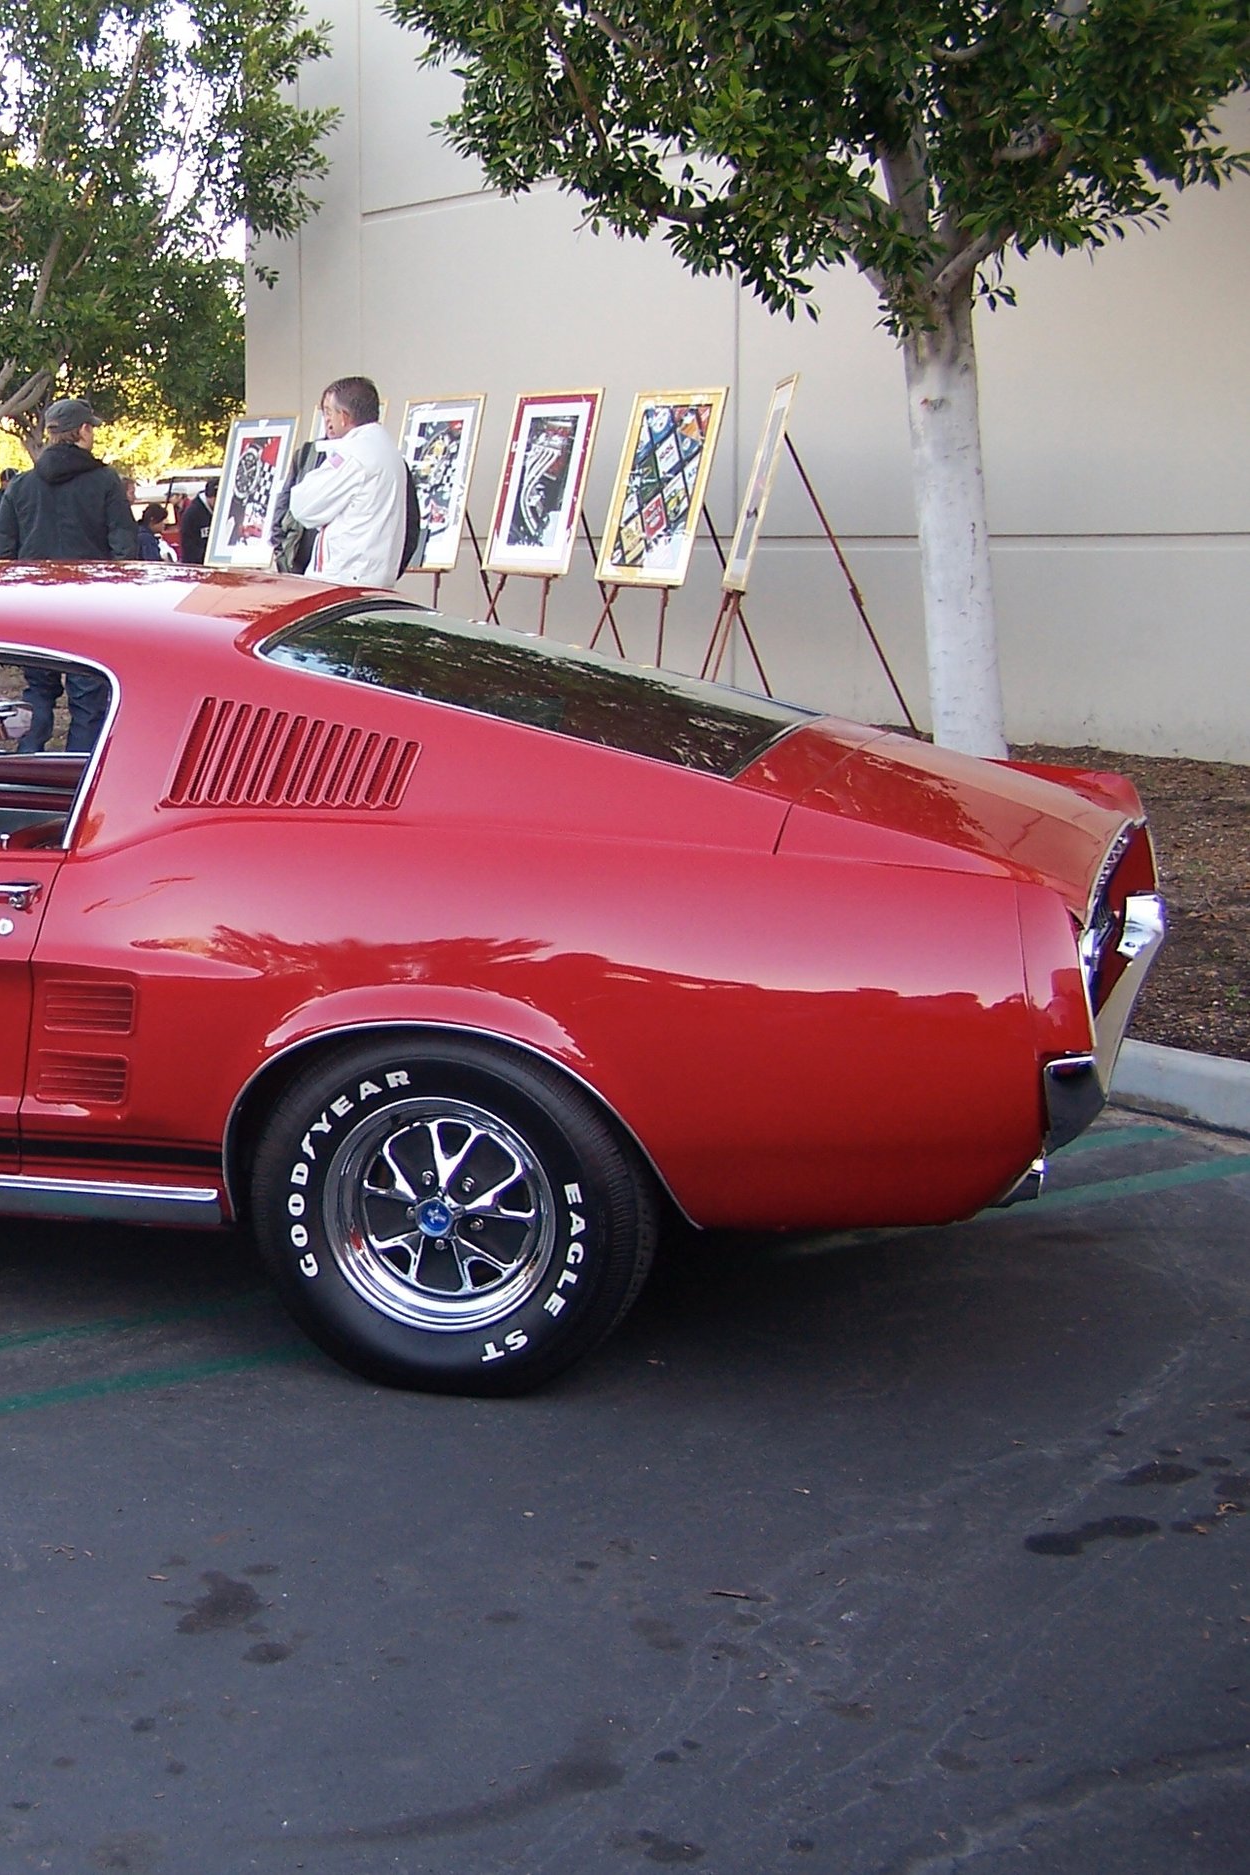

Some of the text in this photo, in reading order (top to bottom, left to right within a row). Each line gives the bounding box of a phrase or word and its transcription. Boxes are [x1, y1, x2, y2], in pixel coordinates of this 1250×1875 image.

[288, 1070, 411, 1278] GOODYEAR
[480, 1182, 586, 1362] EAGLE ST
